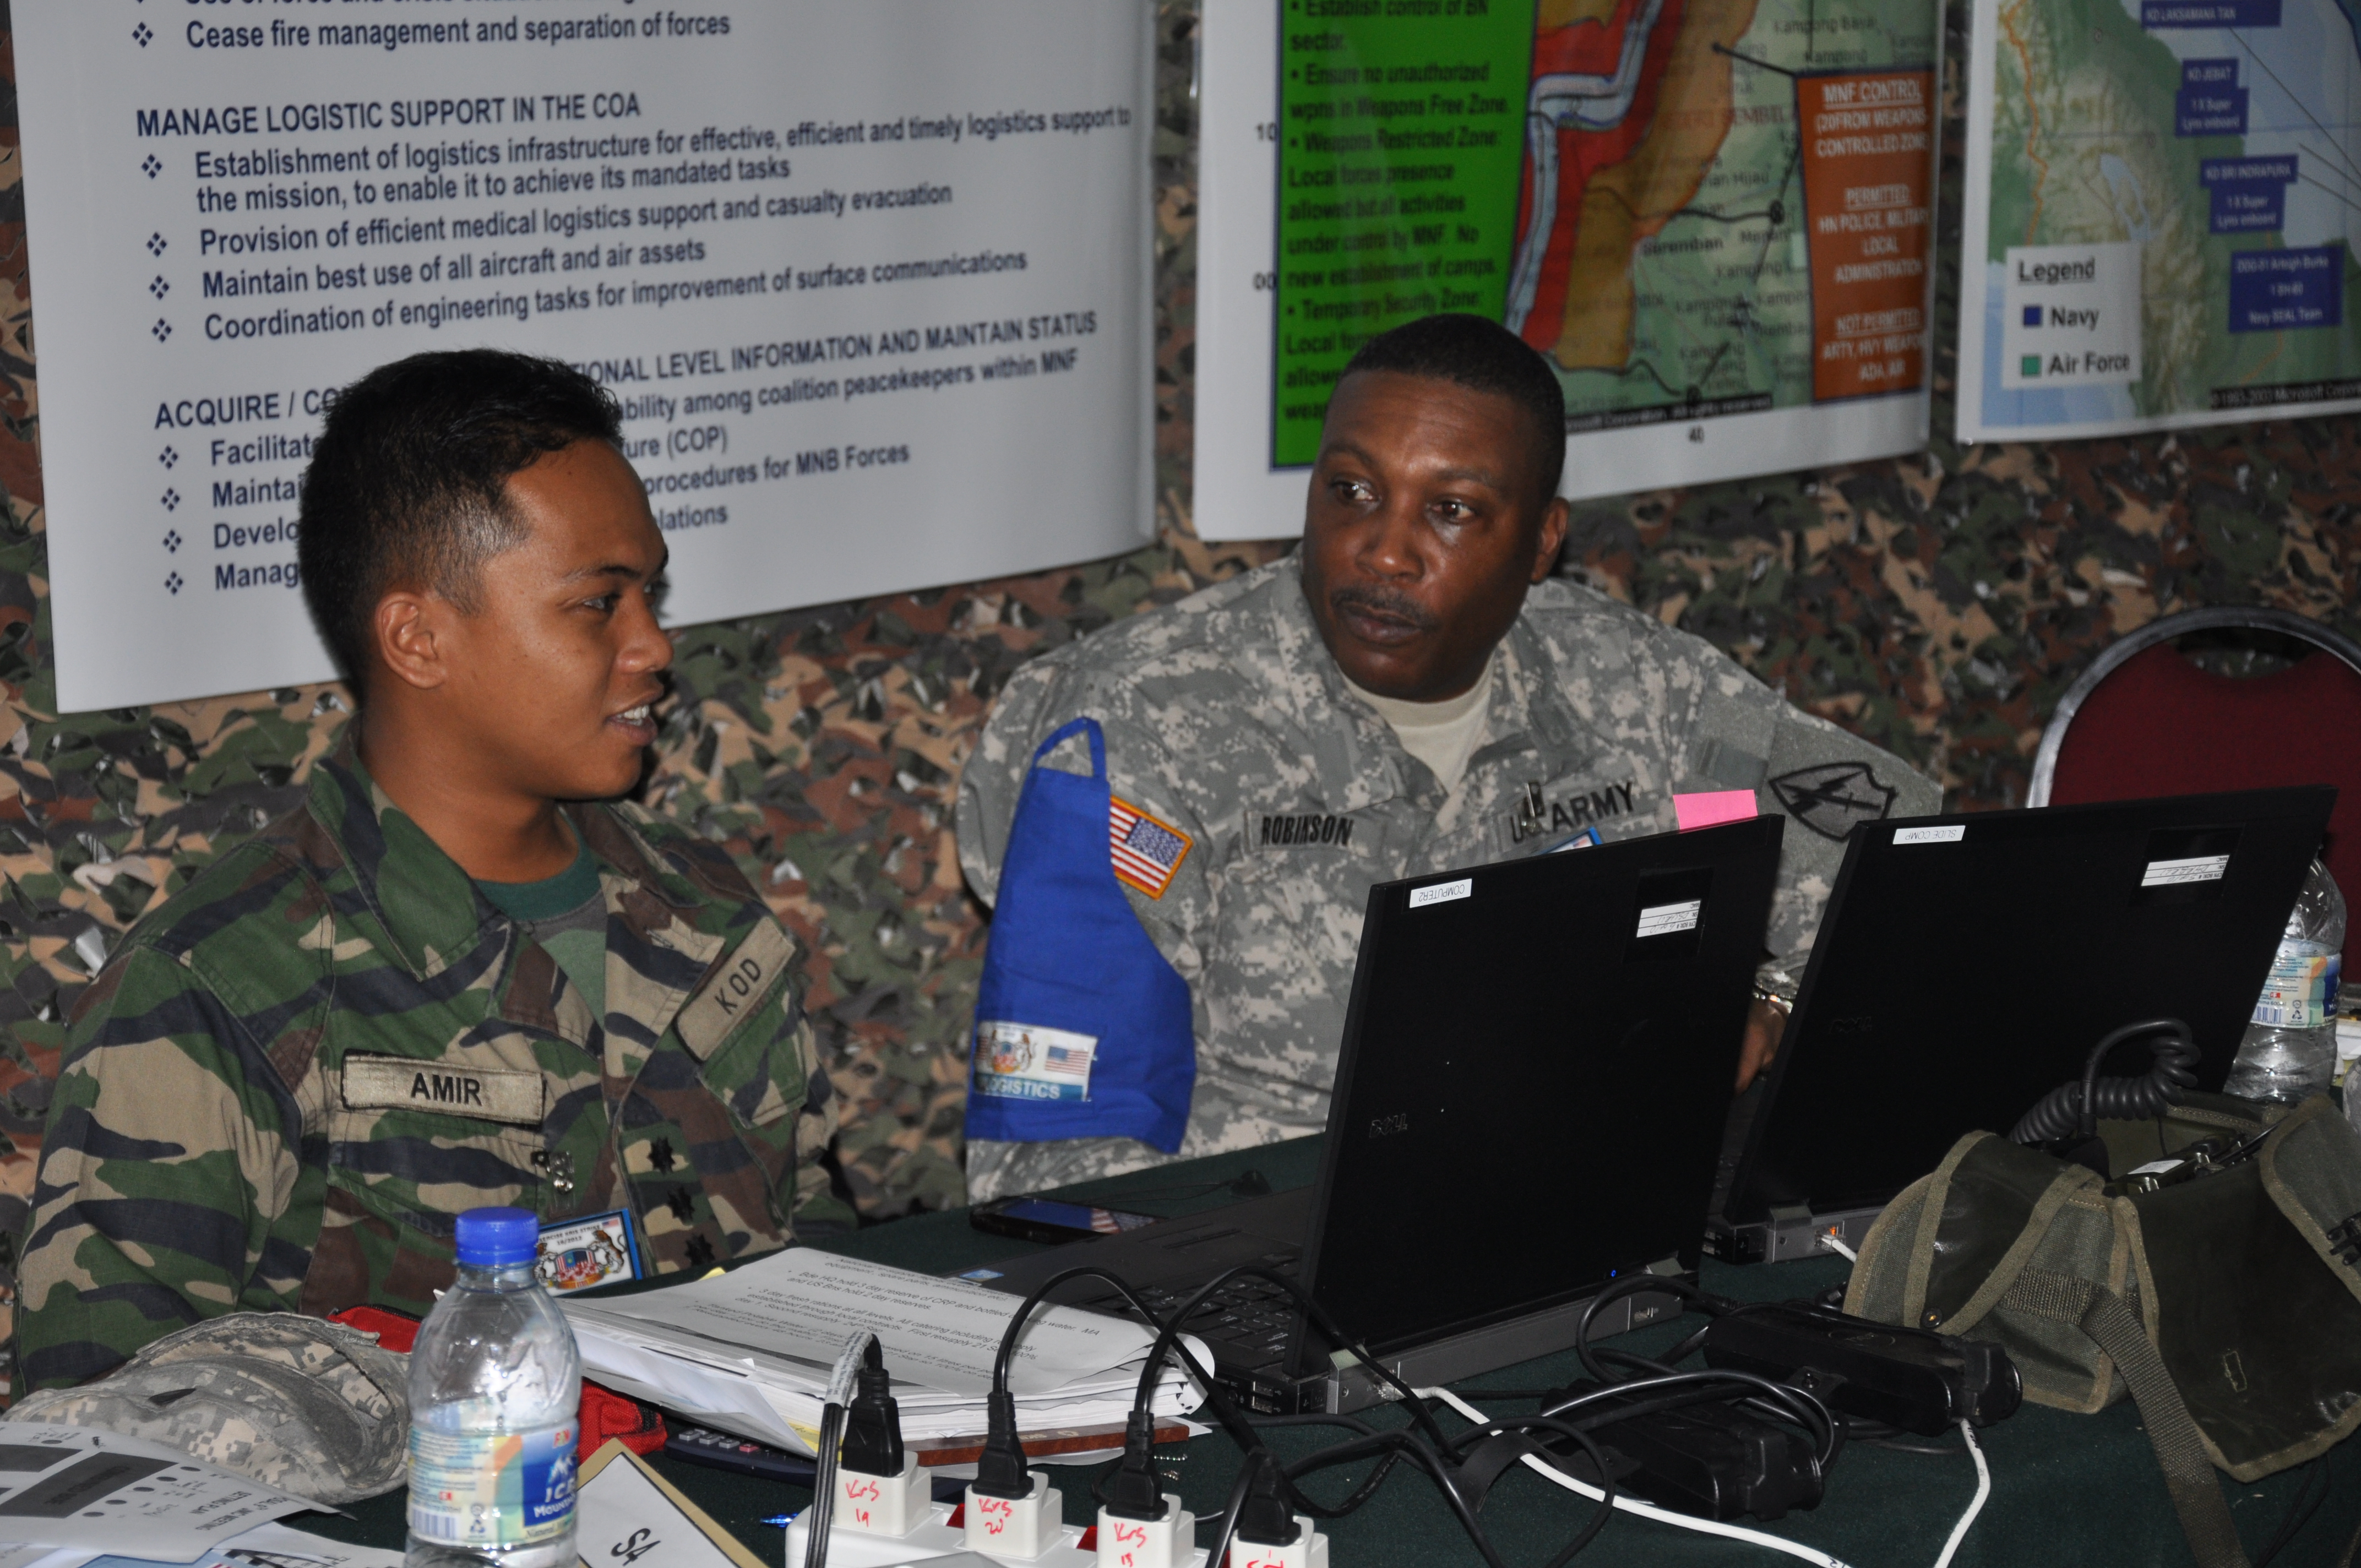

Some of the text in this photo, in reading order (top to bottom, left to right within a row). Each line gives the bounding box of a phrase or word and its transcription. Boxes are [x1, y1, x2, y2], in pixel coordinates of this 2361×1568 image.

[186, 11, 730, 51] Cease fire management and separation of forces
[137, 92, 641, 137] MANAGE LOGISTIC SUPPORT IN THE COA
[195, 108, 1131, 178] Establishment of logistics infrastructure for effective, efficient and timely logistics support to
[196, 156, 790, 213] the mission, to enable it to achieve its mandated tasks
[1288, 167, 1335, 189] Local
[200, 186, 951, 255] Provision of efficient medical logistics support and casualty evacuation
[203, 239, 706, 298] Maintain best use of all aircraft and air assets
[2017, 257, 2096, 285] Legend
[205, 253, 1027, 341] Coordination of engineering tasks for improvement of surface communications
[2049, 305, 2099, 330] Navy
[154, 393, 280, 429] ACQUIRE
[657, 350, 725, 379] LEVEL
[732, 335, 872, 370] INFORMATION
[878, 329, 920, 354] AND
[926, 320, 1022, 349] MAINTAIN
[1029, 311, 1096, 340] STATUS
[2048, 351, 2131, 377] Air Force
[210, 347, 1078, 467] Facilitat among coalition peacekeepers within MNF
[667, 426, 727, 459] (COP)
[764, 456, 790, 479] for
[796, 448, 839, 475] MNB
[846, 445, 910, 467] Forces
[1551, 781, 1636, 834] ARMY
[1261, 814, 1354, 848] ROBINSON
[1905, 829, 1957, 841] SLIDE COMP
[1418, 883, 1466, 903] COMPUTER2
[714, 957, 763, 1016] KOD
[410, 1071, 483, 1106] AMIR
[1368, 1113, 1408, 1139] DELL
[822, 1283, 842, 1292] Bns
[841, 1287, 865, 1296] hold
[871, 1294, 891, 1302] day
[890, 1298, 932, 1310] reserves.
[883, 1289, 920, 1299] reserve
[931, 1298, 956, 1306] CRP
[975, 1306, 1010, 1319] bottled
[1047, 1322, 1077, 1331] water.
[786, 1294, 810, 1303] fresh
[810, 1300, 842, 1310] rations
[896, 1317, 913, 1326] All
[911, 1321, 950, 1334] catering
[950, 1329, 994, 1344] including
[545, 1477, 576, 1504] ICE
[610, 1527, 661, 1567] S4
